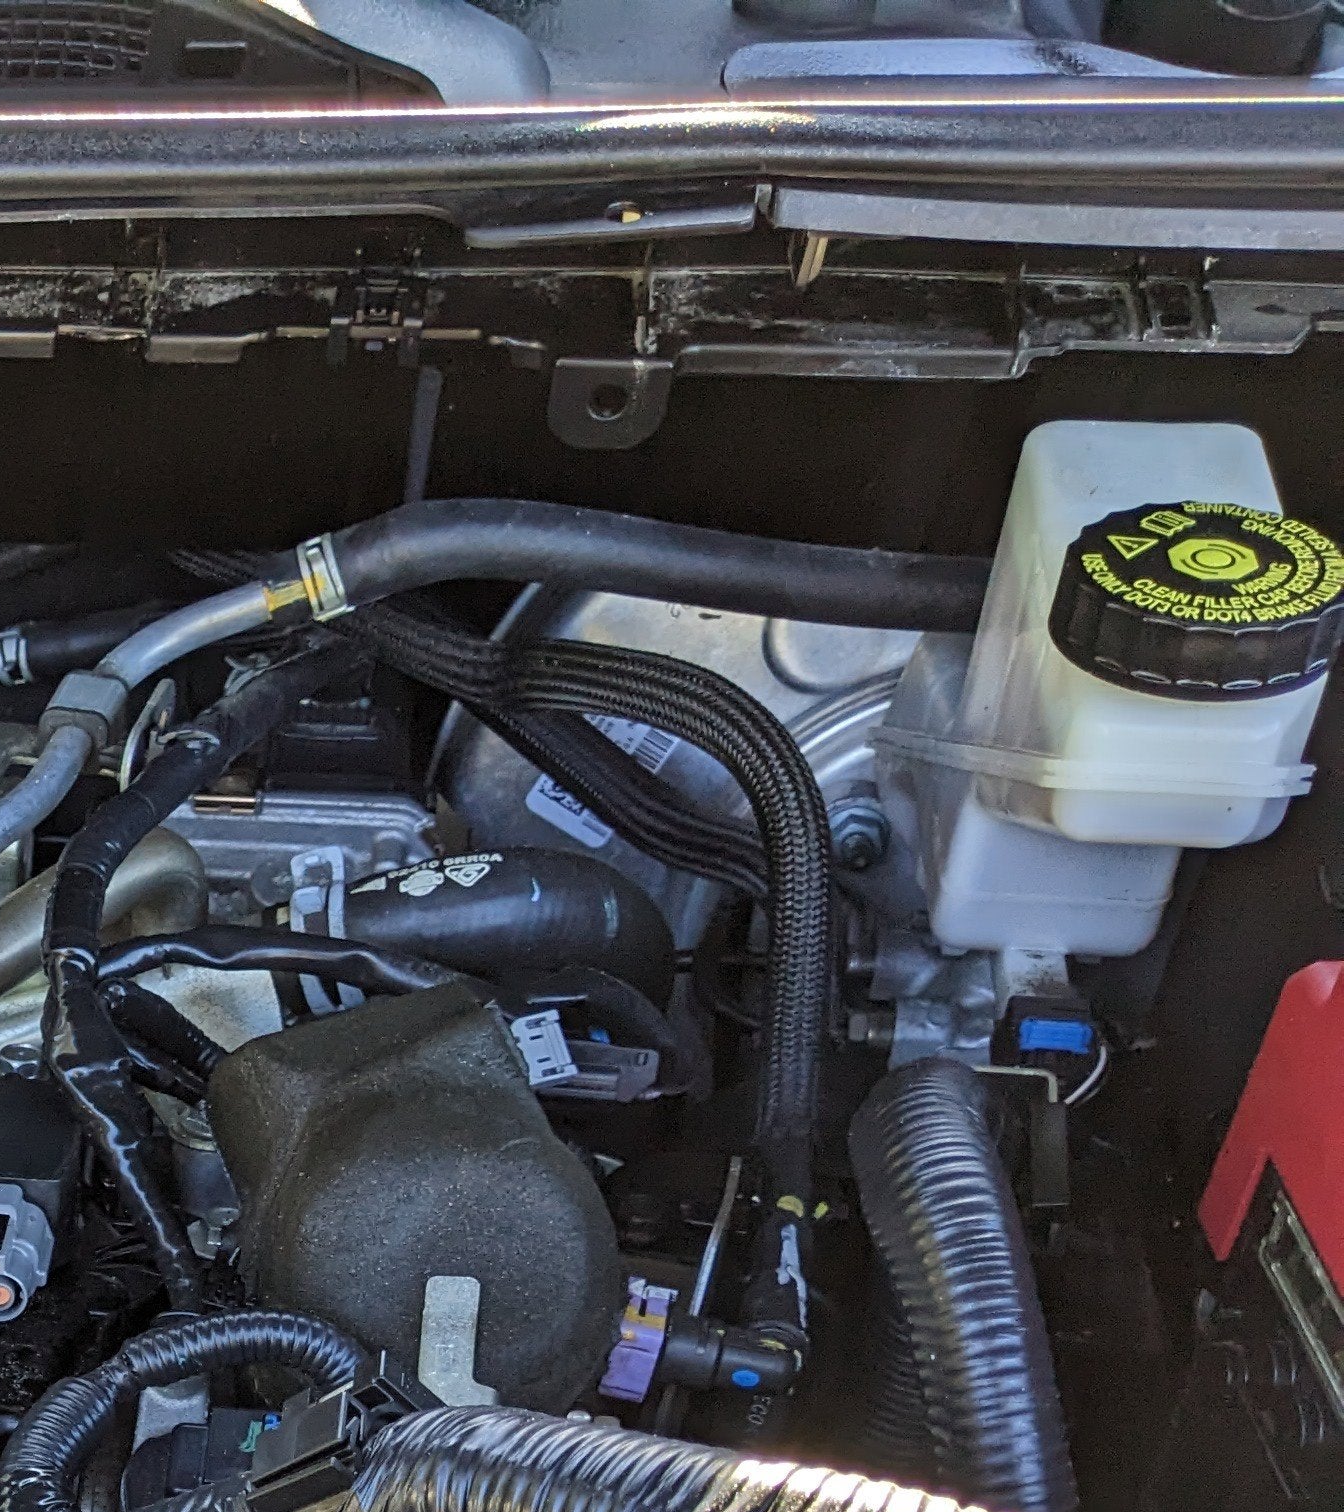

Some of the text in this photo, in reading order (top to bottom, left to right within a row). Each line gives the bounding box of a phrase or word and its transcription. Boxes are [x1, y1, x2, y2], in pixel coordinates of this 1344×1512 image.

[1180, 502, 1284, 525] CONTAINER
[1280, 519, 1335, 552] SEALED
[1080, 552, 1109, 573] USE
[1132, 518, 1320, 610] CLEAN FILLER CAP BEFORE REMOVING
[1091, 571, 1132, 595] ONLY
[1231, 561, 1292, 596] WARNING
[1123, 590, 1172, 614] DOT3
[1302, 581, 1342, 608] FLUID
[1172, 604, 1200, 620] OR
[1203, 608, 1252, 623] DOT4
[1252, 599, 1314, 622] BRAKE
